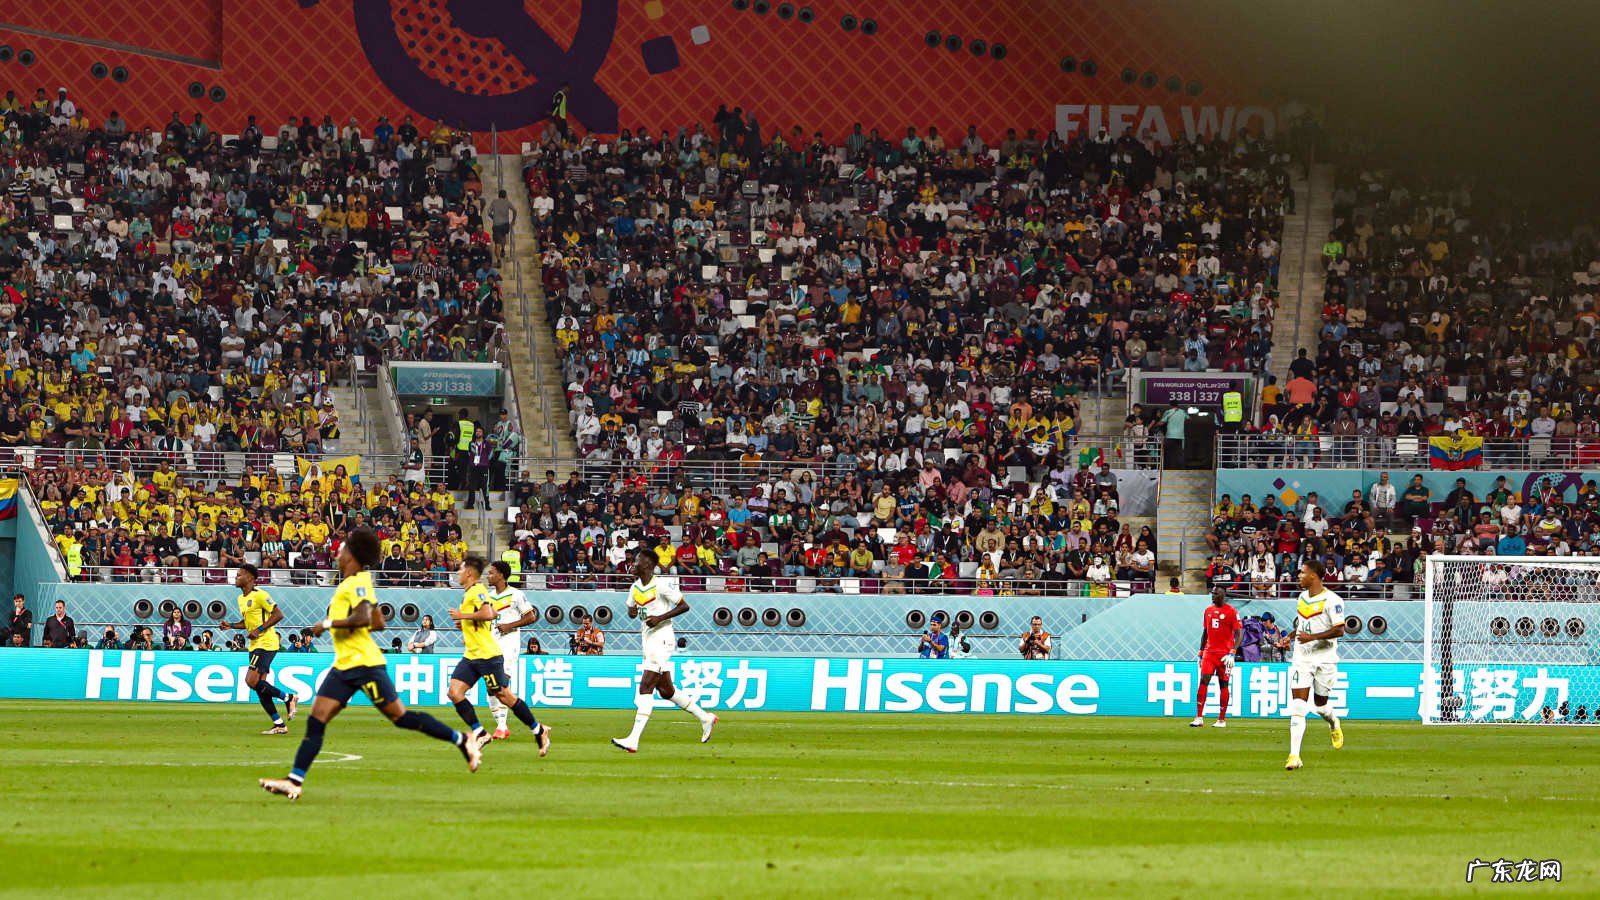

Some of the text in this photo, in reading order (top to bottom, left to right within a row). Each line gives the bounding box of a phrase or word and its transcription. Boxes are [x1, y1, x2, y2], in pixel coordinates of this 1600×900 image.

[1056, 104, 1277, 146] FIFA WO
[421, 381, 472, 392] 339 338
[1169, 391, 1219, 401] 338 337
[1211, 618, 1220, 629] 16
[85, 650, 353, 702] Hisens
[395, 656, 575, 706] 中造
[484, 673, 496, 686] 21
[810, 658, 1100, 714] Hisense
